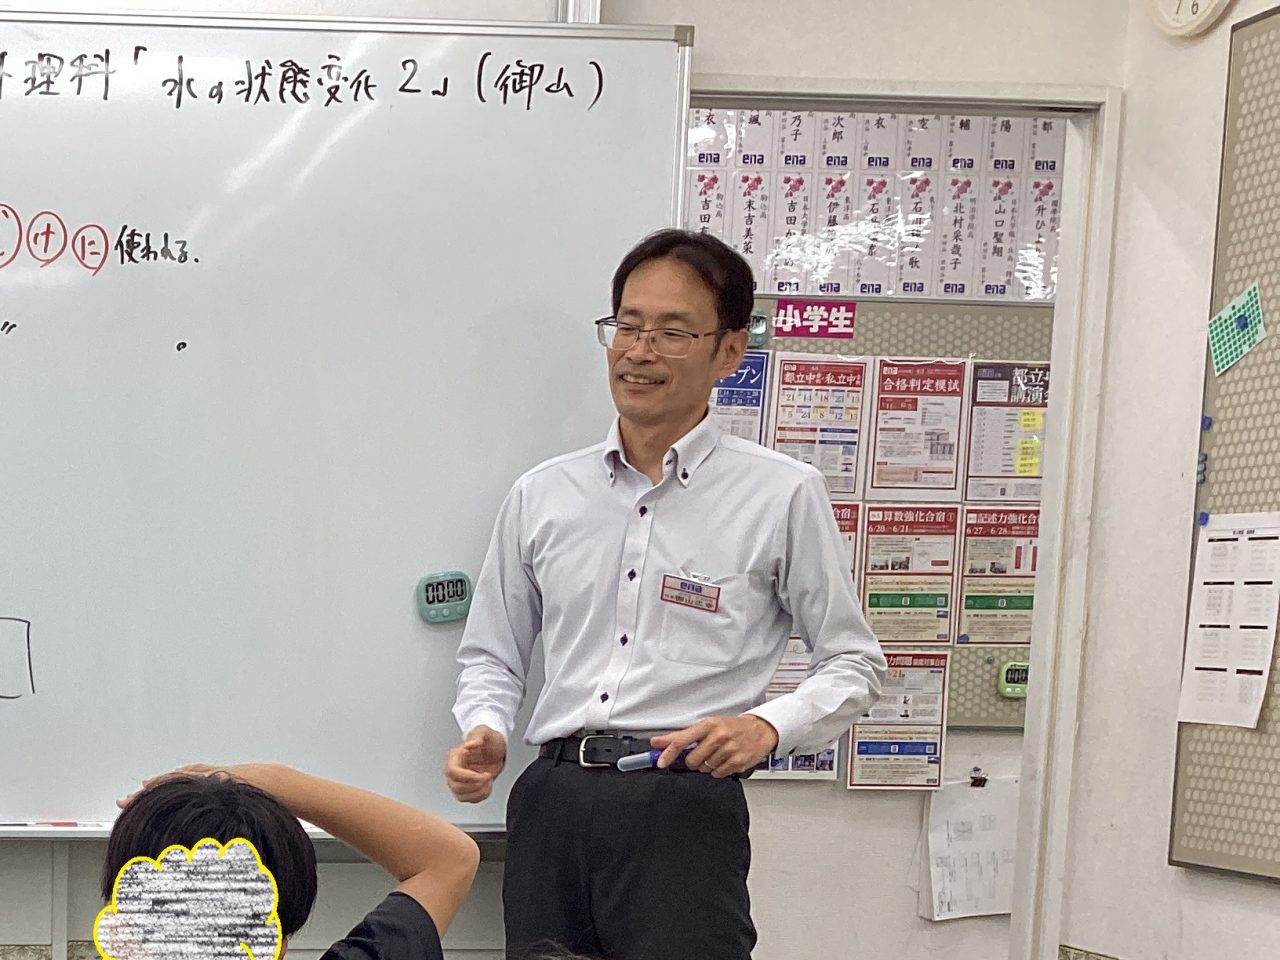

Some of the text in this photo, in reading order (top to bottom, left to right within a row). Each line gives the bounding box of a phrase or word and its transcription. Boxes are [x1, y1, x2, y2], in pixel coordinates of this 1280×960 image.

[698, 152, 720, 163] ena
[742, 154, 764, 165] ena
[784, 154, 806, 165] ena
[826, 155, 848, 167] ena
[868, 156, 889, 167] ena
[911, 157, 932, 168] ena
[952, 158, 974, 169] ena
[993, 159, 1015, 170] ena
[1035, 160, 1056, 171] ena
[819, 282, 840, 293] ena
[860, 283, 881, 294] ena
[903, 282, 924, 292] ena
[944, 283, 965, 293] ena
[985, 284, 1006, 295] ena
[775, 304, 853, 333] 小学生
[883, 378, 960, 392] 合格判定模試
[977, 512, 1040, 524] 記述力強化合
[680, 581, 702, 593] ena
